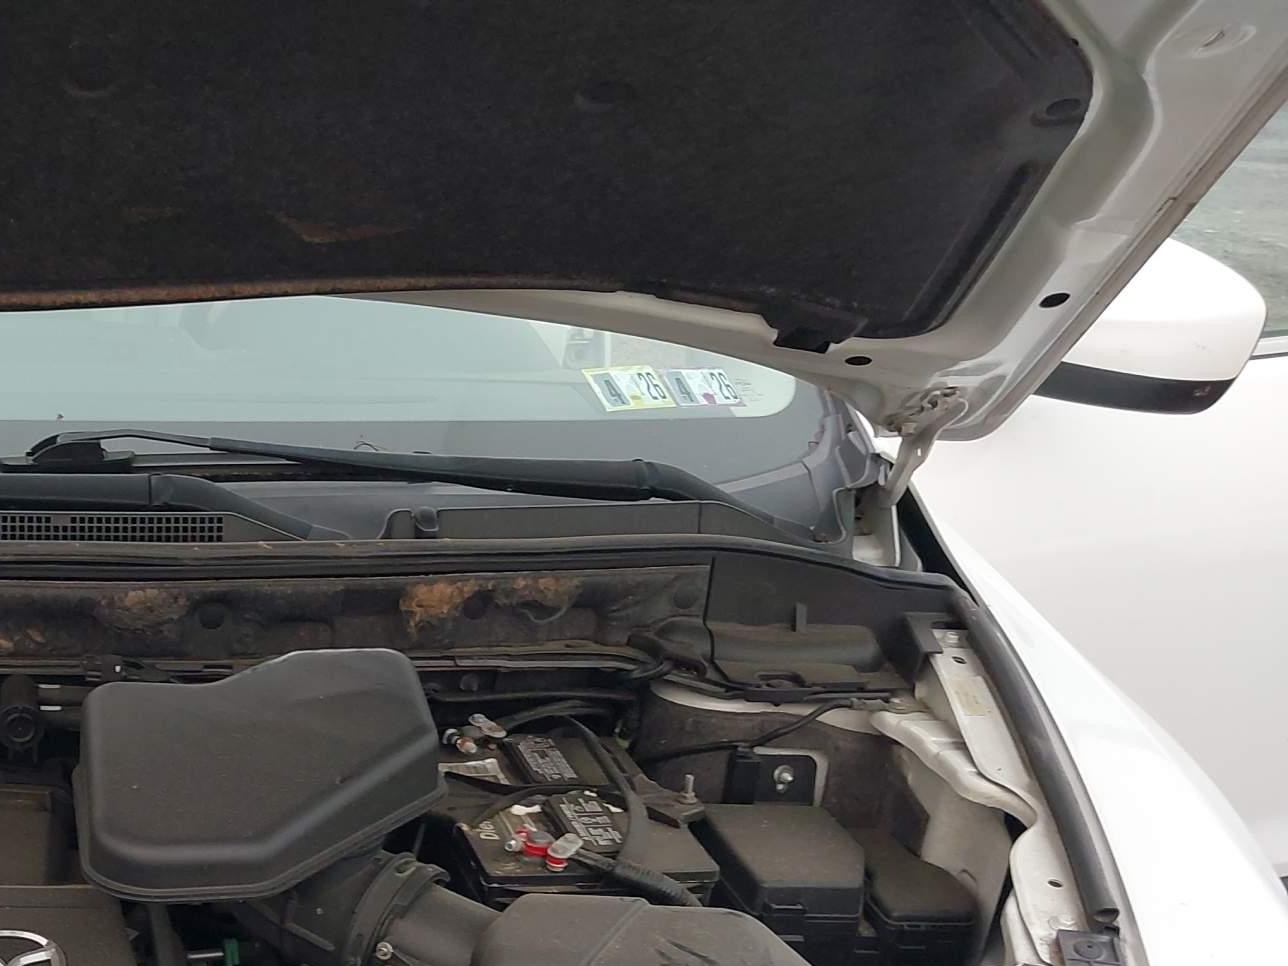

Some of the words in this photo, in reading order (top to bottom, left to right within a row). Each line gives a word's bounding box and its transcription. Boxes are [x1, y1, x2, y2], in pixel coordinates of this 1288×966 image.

[603, 379, 626, 405] 4
[637, 372, 667, 400] 26
[674, 377, 694, 402] 4
[710, 372, 738, 400] 26
